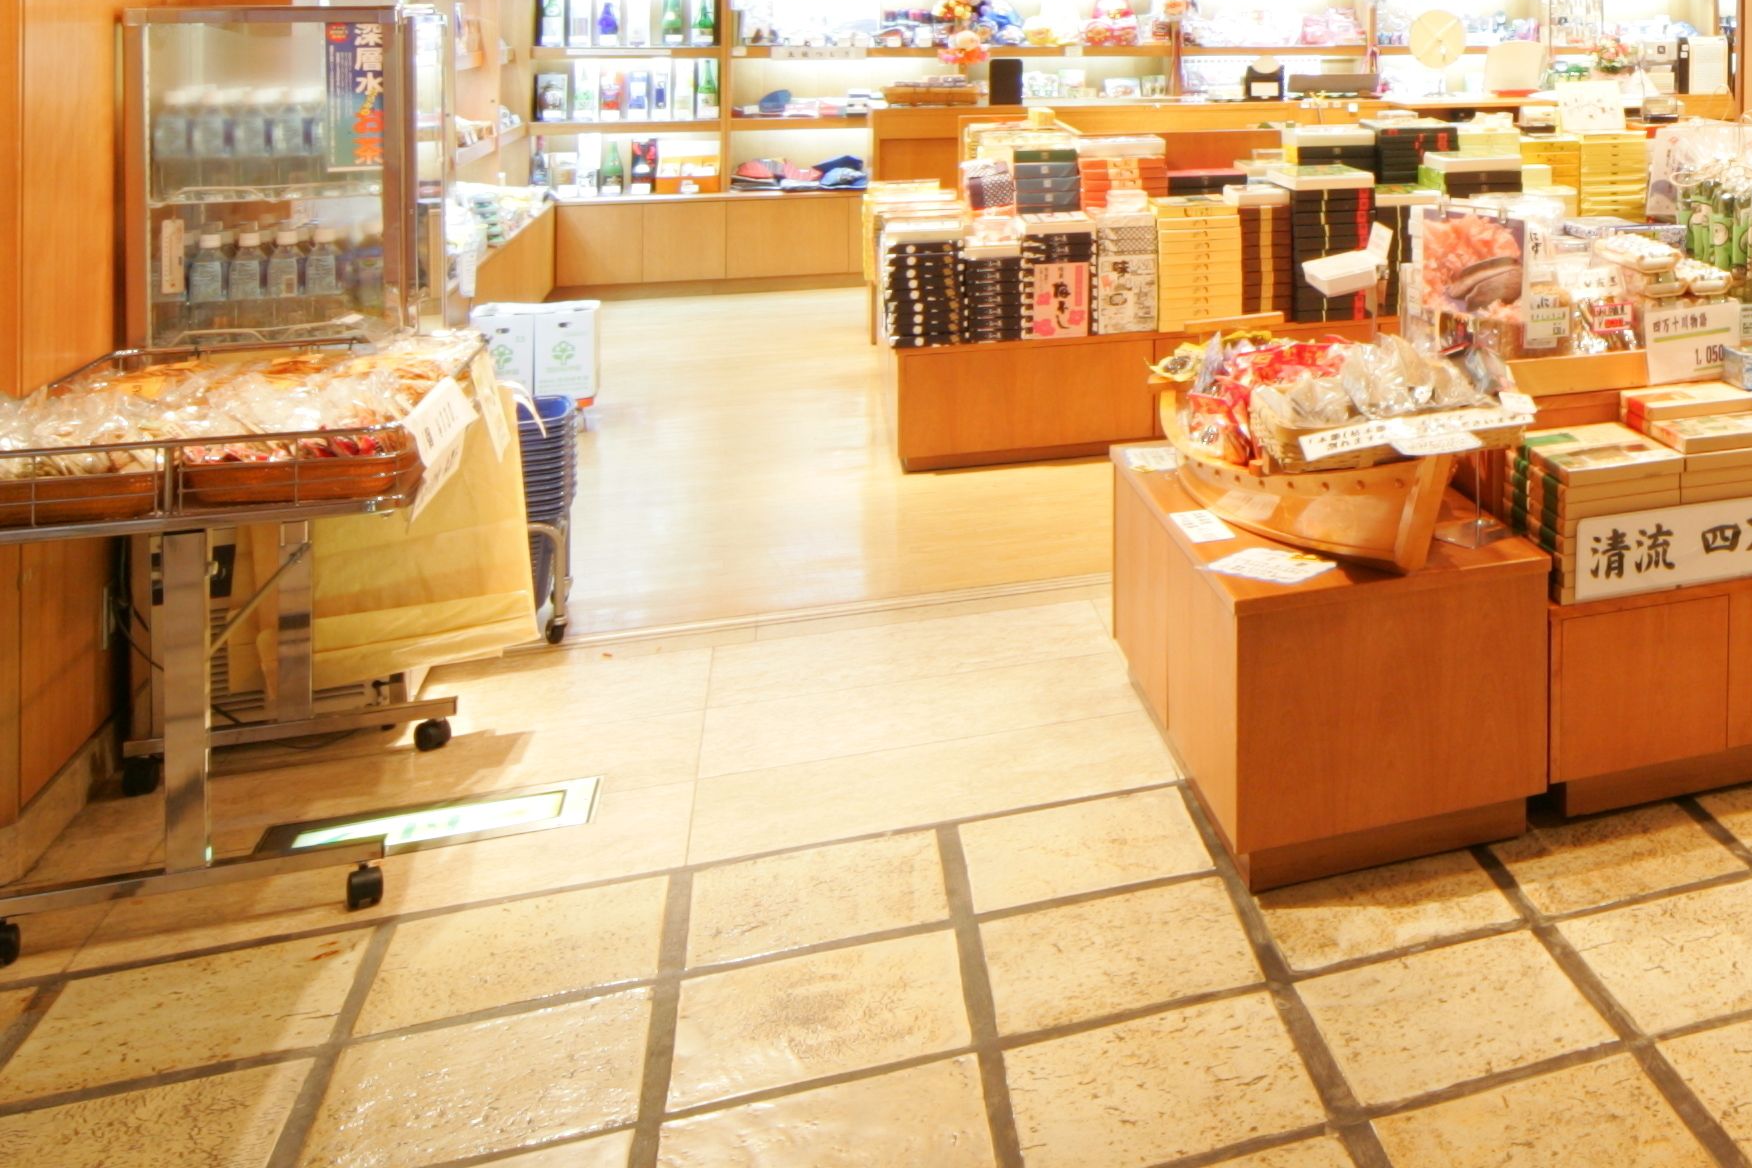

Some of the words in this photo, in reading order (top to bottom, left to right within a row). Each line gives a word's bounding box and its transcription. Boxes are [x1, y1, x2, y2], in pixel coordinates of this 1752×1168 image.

[354, 23, 384, 96] 深層水
[1653, 312, 1707, 333] 四万十川物語
[1589, 524, 1676, 580] 清流
